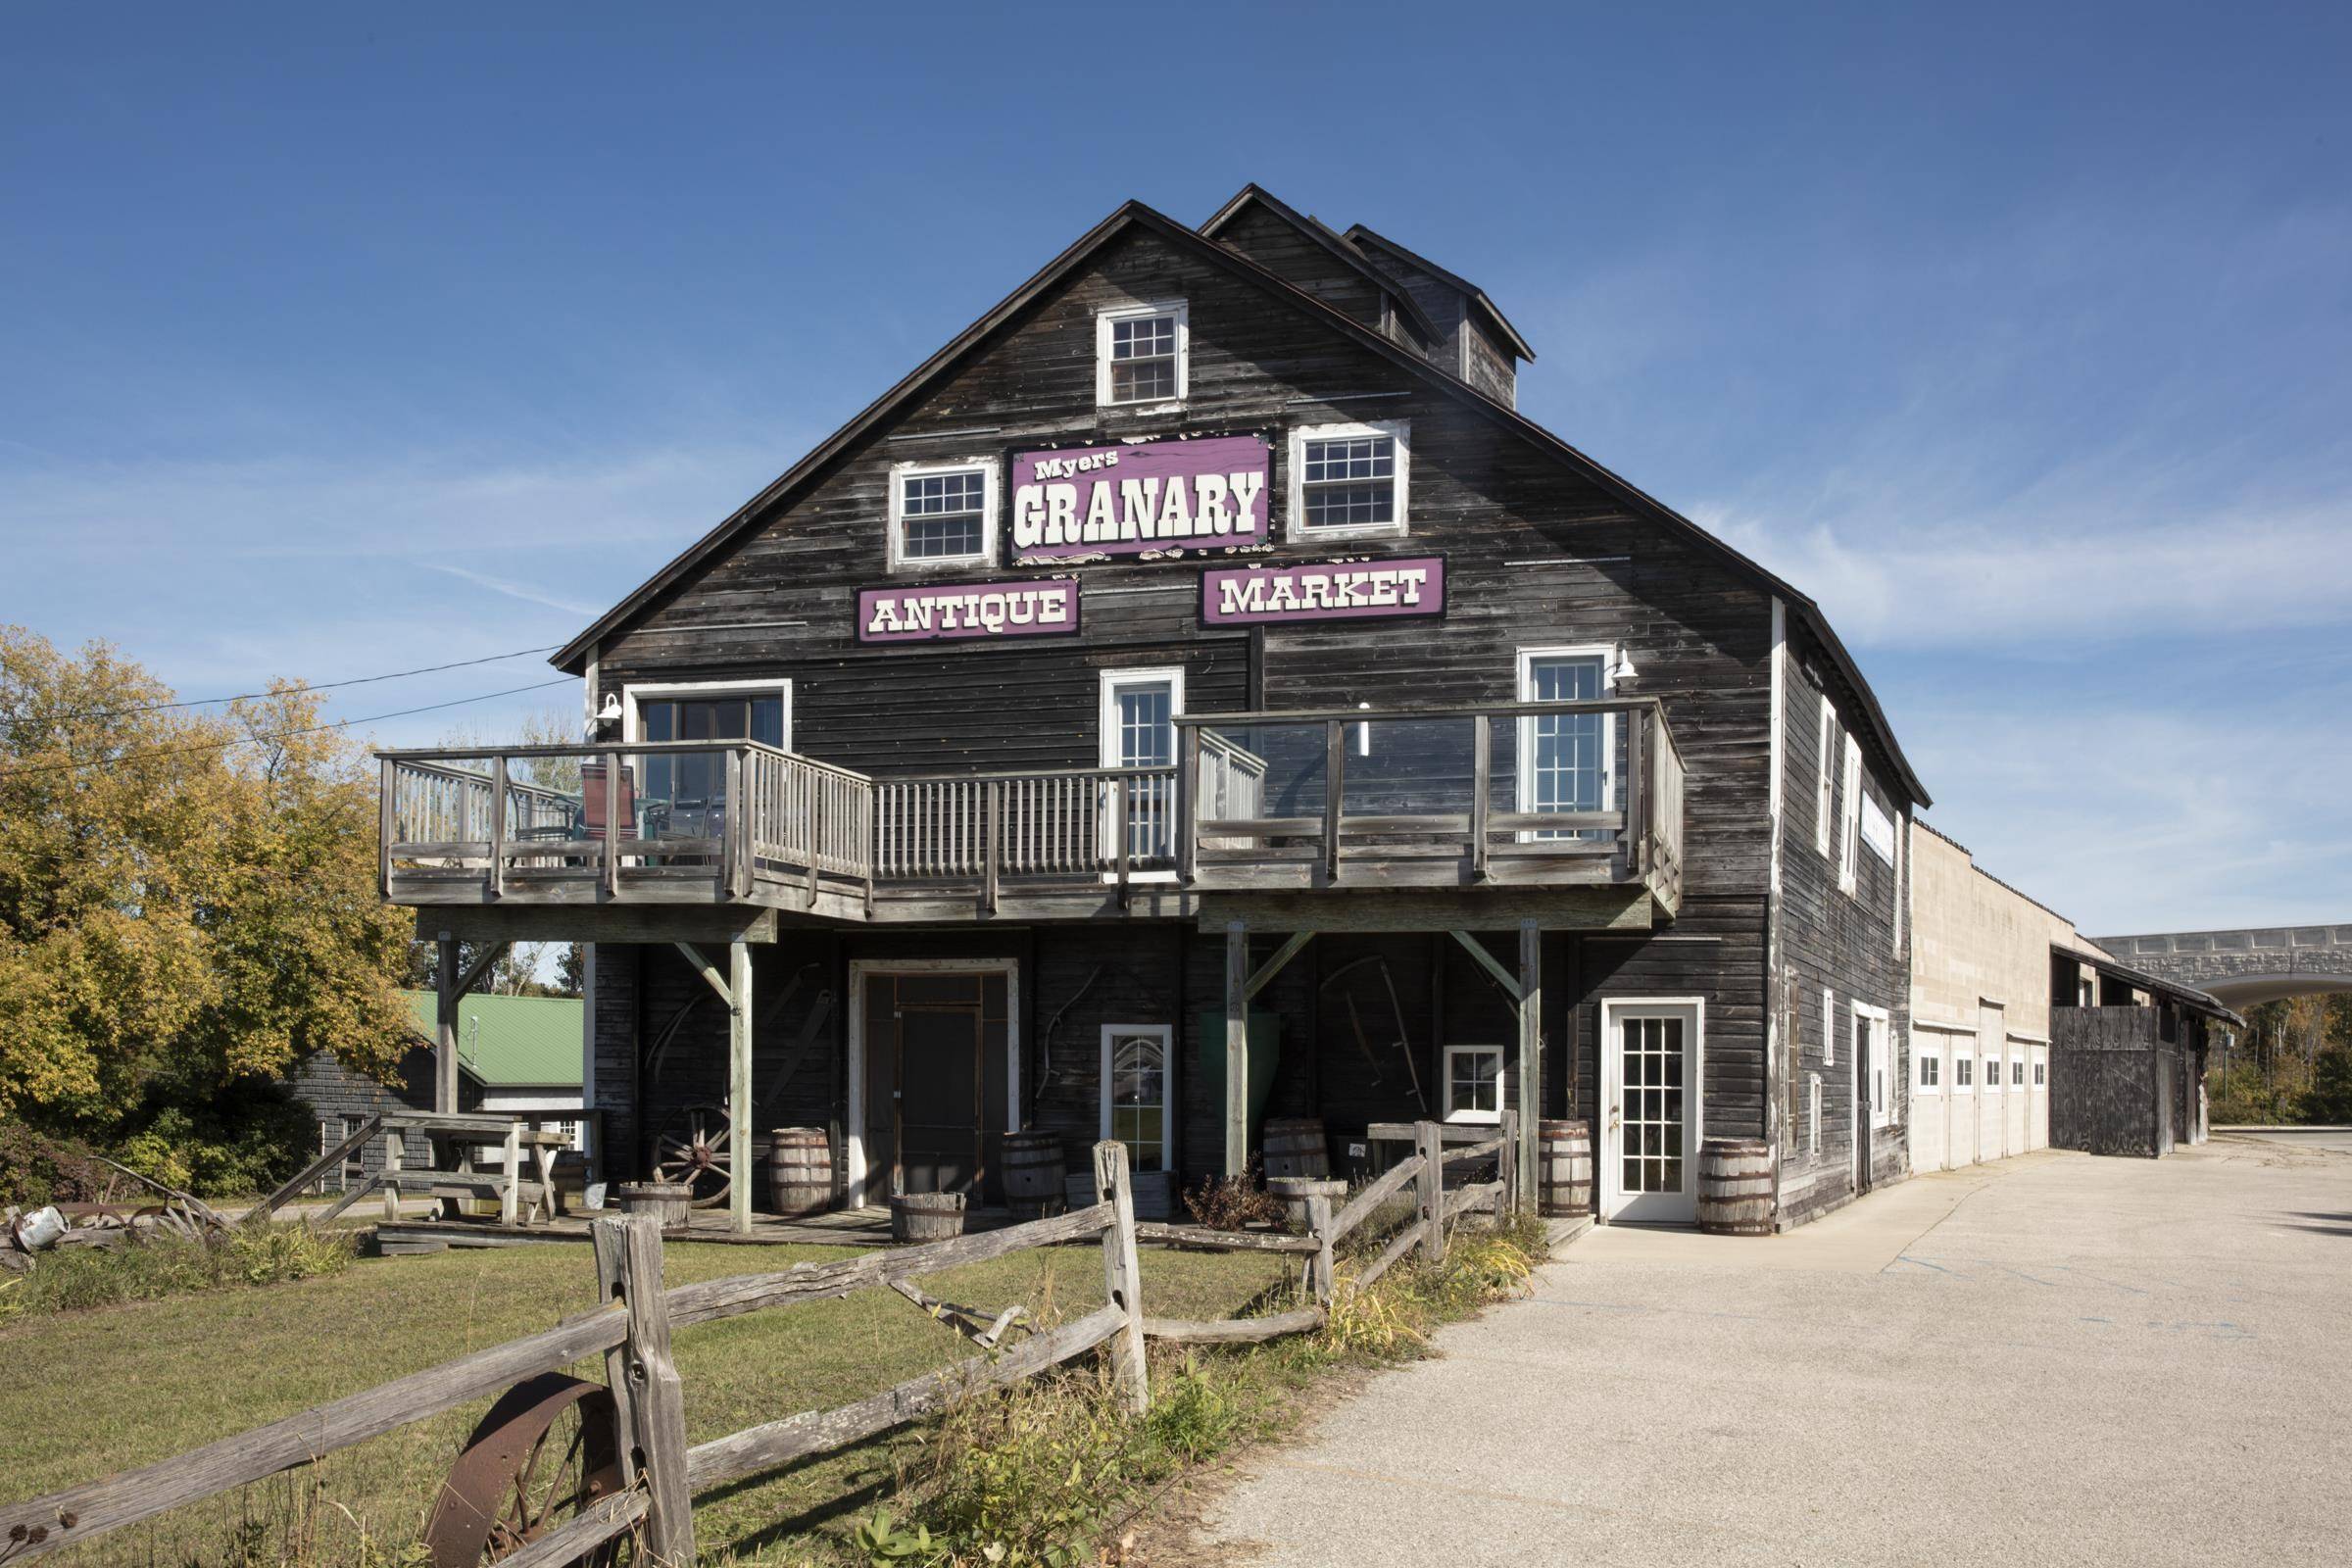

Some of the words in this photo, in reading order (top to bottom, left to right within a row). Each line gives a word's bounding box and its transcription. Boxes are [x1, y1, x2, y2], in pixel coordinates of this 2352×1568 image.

[1034, 451, 1119, 480] Myers
[1013, 471, 1263, 549] GRANARY
[868, 589, 1067, 632] ANTIQUE
[1221, 568, 1427, 613] MARKET
